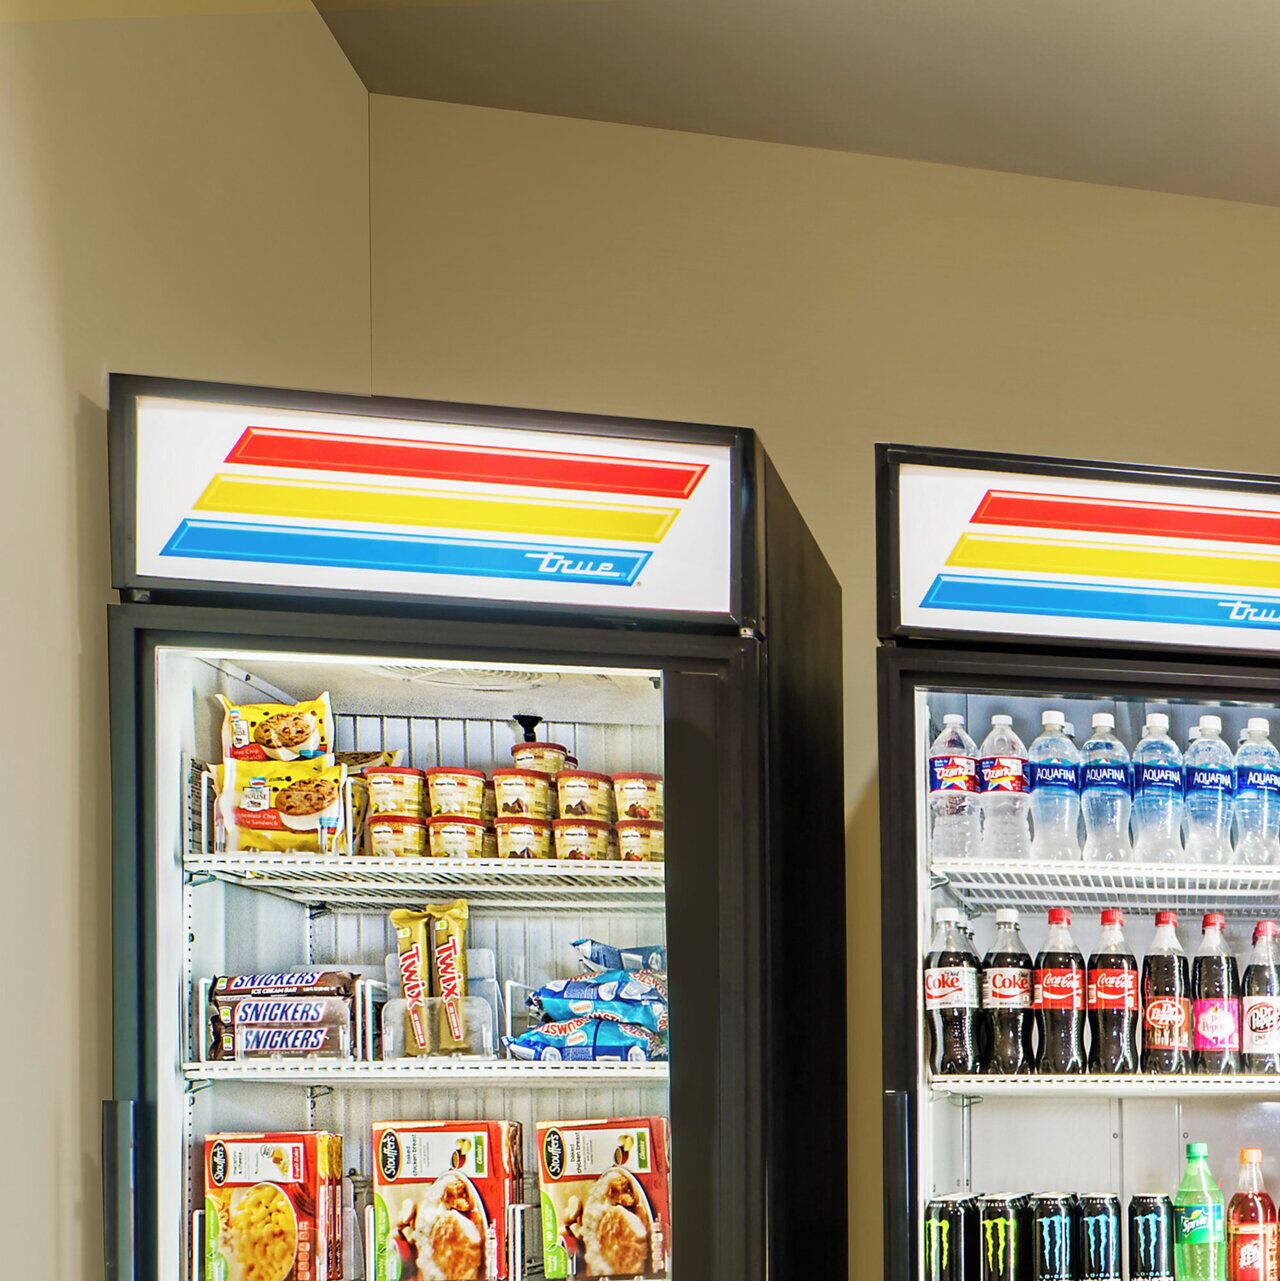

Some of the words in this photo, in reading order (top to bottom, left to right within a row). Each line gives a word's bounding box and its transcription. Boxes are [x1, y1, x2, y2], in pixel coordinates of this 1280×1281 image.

[1036, 767, 1076, 784] AQUAFINA
[1086, 768, 1126, 783] AQUAFINA
[1142, 768, 1181, 785] AQUAFINA
[1193, 771, 1232, 788] AQUAFINA
[925, 973, 960, 990] Coke
[991, 972, 1029, 990] Coke
[240, 1001, 324, 1022] SNICKERS
